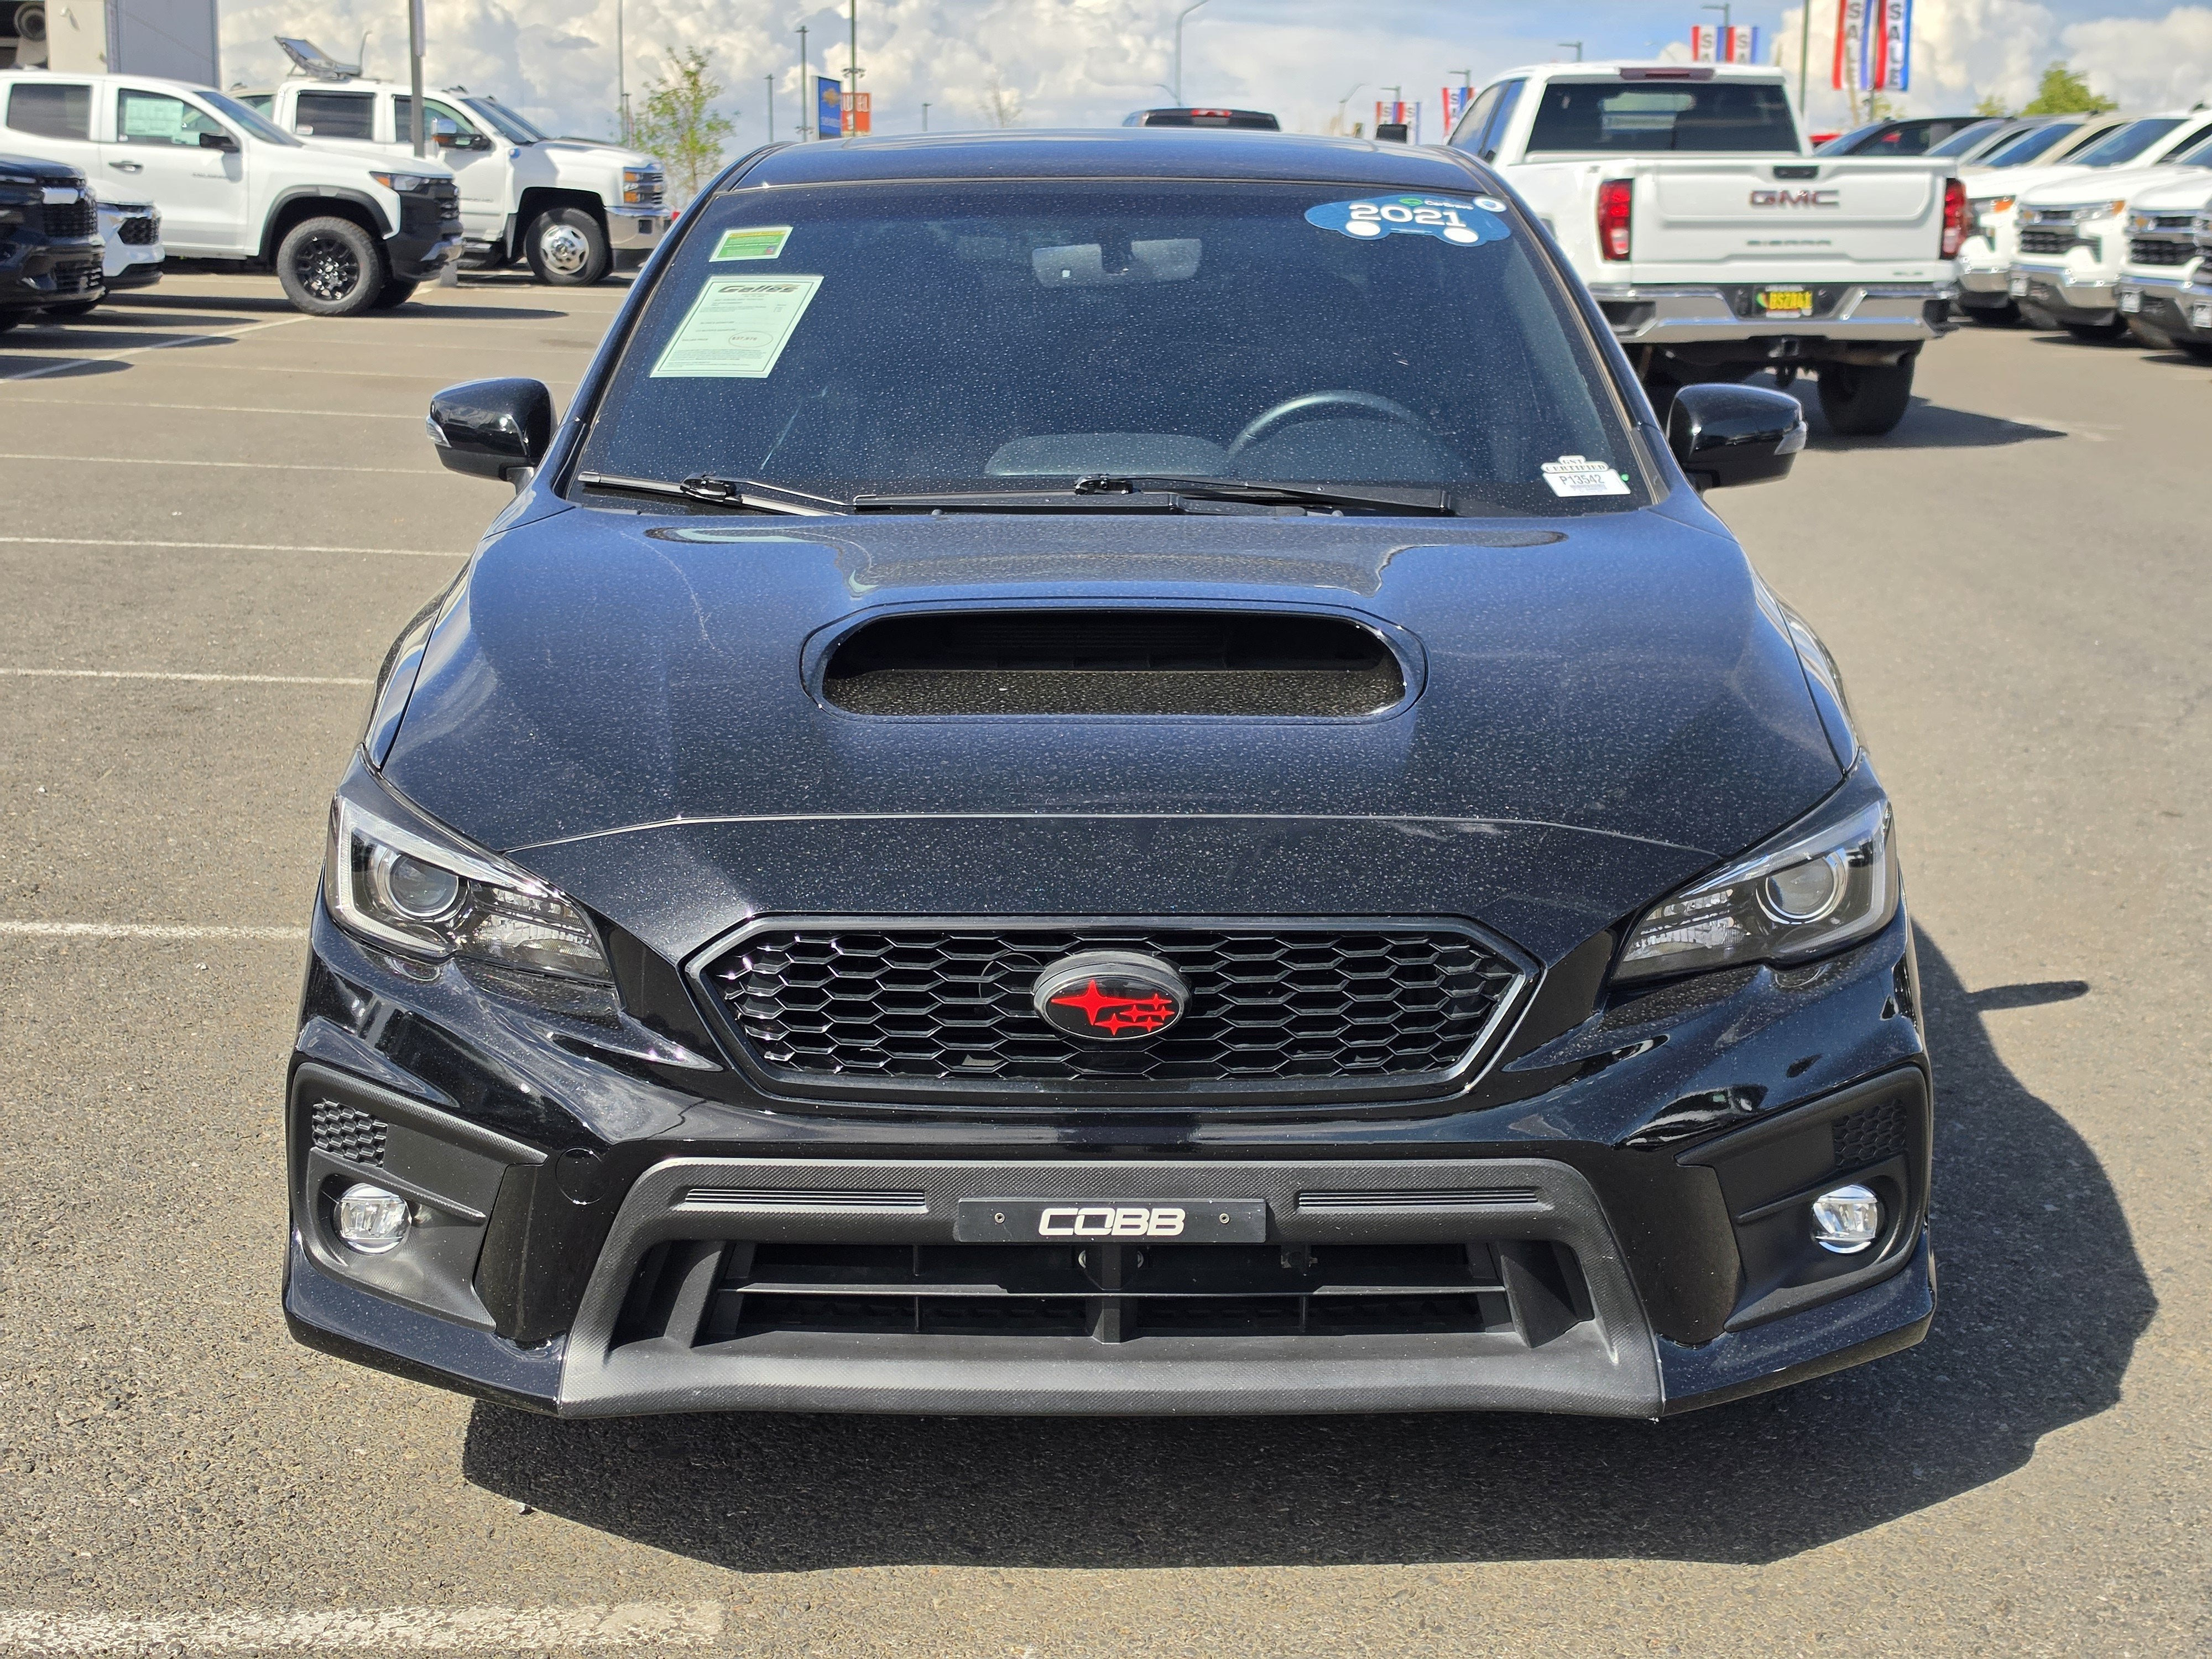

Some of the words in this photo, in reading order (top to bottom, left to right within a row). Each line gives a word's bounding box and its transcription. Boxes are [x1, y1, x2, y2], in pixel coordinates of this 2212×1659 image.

[1750, 189, 1840, 206] GMC
[1349, 203, 1467, 227] 2021
[1559, 474, 1605, 485] P13542
[1038, 1207, 1186, 1237] COBB
